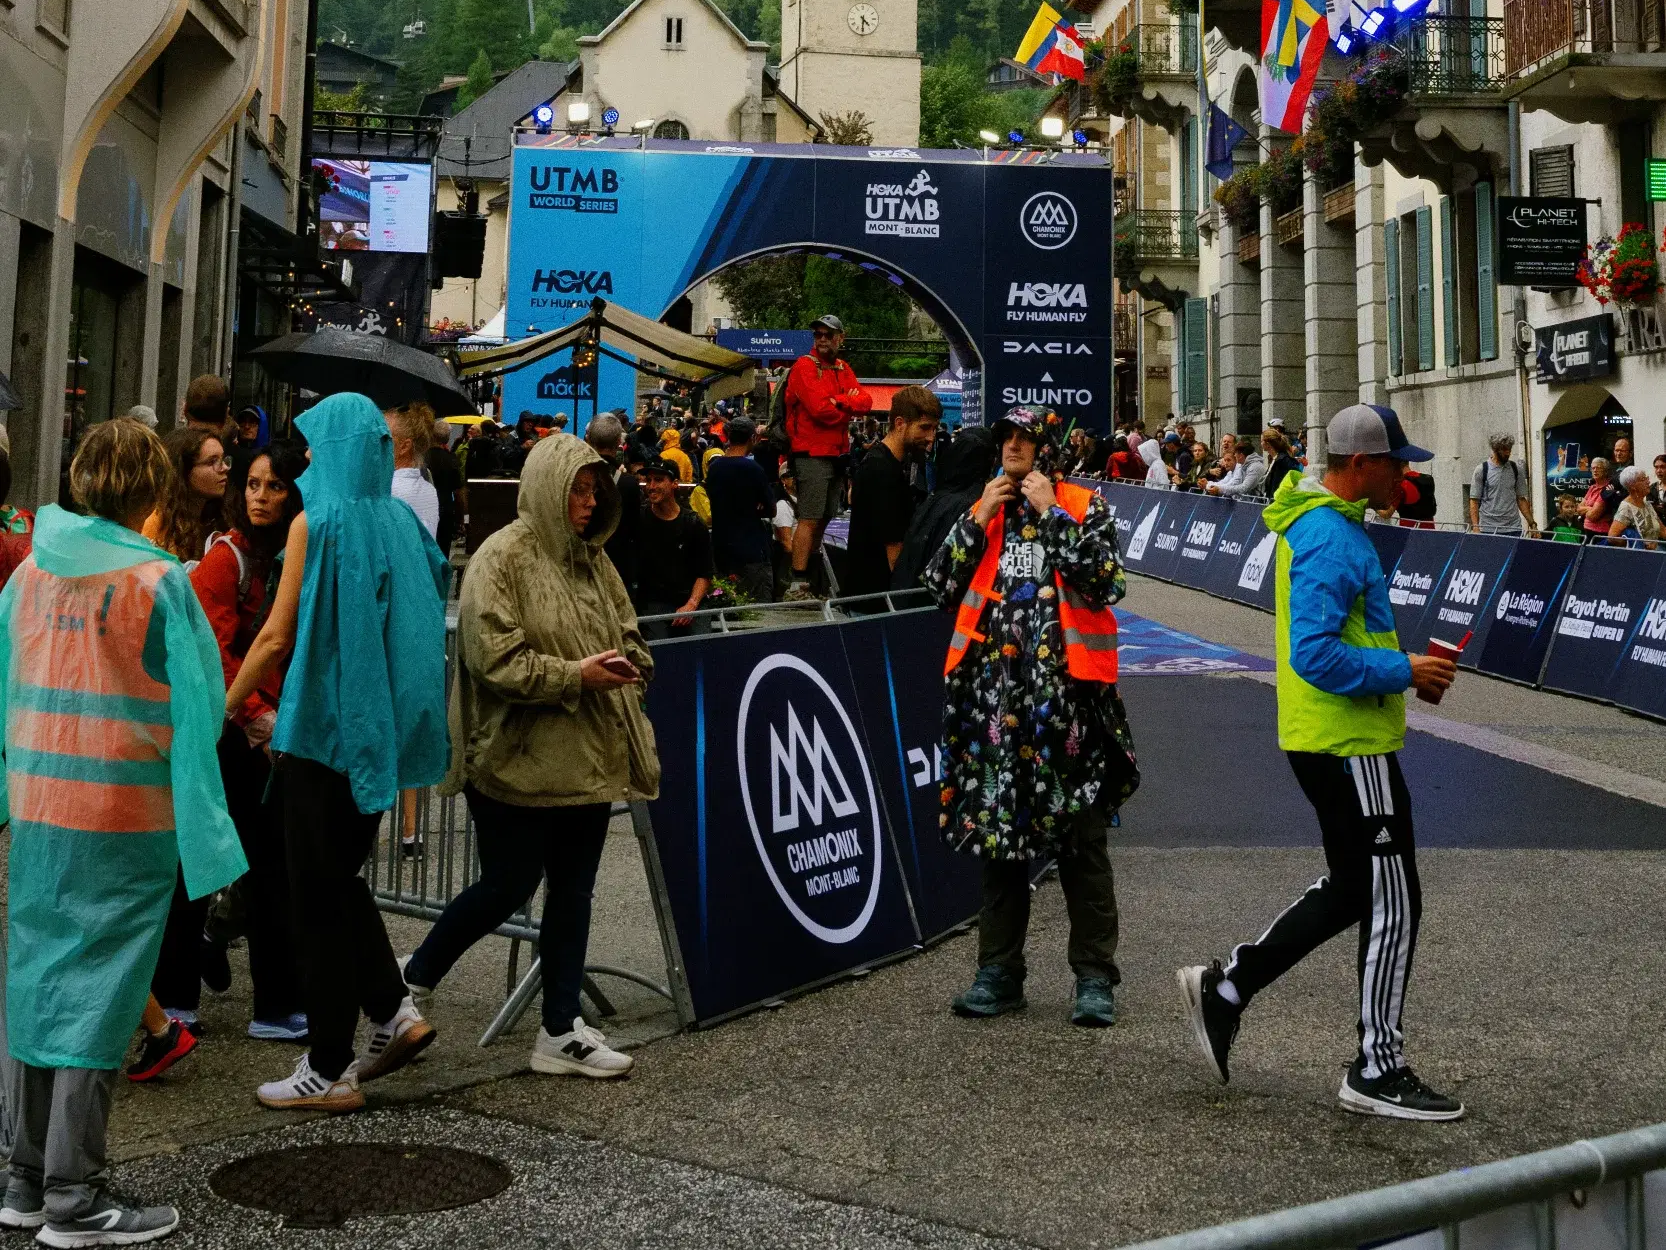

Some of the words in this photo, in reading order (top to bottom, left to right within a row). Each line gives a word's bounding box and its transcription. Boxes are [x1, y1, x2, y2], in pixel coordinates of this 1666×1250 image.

[530, 166, 619, 193] UTMB
[866, 183, 903, 196] HOKA
[533, 196, 576, 207] WORLD
[579, 201, 615, 211] SERIES
[865, 197, 940, 221] UTMB
[1520, 208, 1577, 217] PLANET
[531, 269, 613, 294] HOKA
[531, 298, 549, 307] FLY
[550, 299, 593, 309] HUMAN
[1007, 282, 1088, 307] HOKA
[1007, 310, 1025, 321] FLY
[1026, 312, 1067, 322] HUMAN
[1069, 312, 1087, 323] FLY
[750, 337, 782, 345] SUUNTO
[1003, 341, 1093, 355] DACIA
[1557, 331, 1589, 352] PLANET
[1002, 387, 1093, 406] SUUNTO
[1154, 532, 1179, 552] SUUNTO
[1186, 520, 1217, 547] HOKA
[1008, 542, 1032, 554] THE
[1004, 565, 1032, 578] ACE
[1444, 568, 1486, 606] HOKA
[1509, 591, 1520, 609] La
[1517, 593, 1544, 616] Région
[1565, 594, 1597, 619] Payot
[1596, 599, 1631, 622] Pertin
[1592, 624, 1617, 640] SUPER
[786, 828, 863, 874] CHAMONIX
[805, 866, 860, 897] MONT-BLANC
